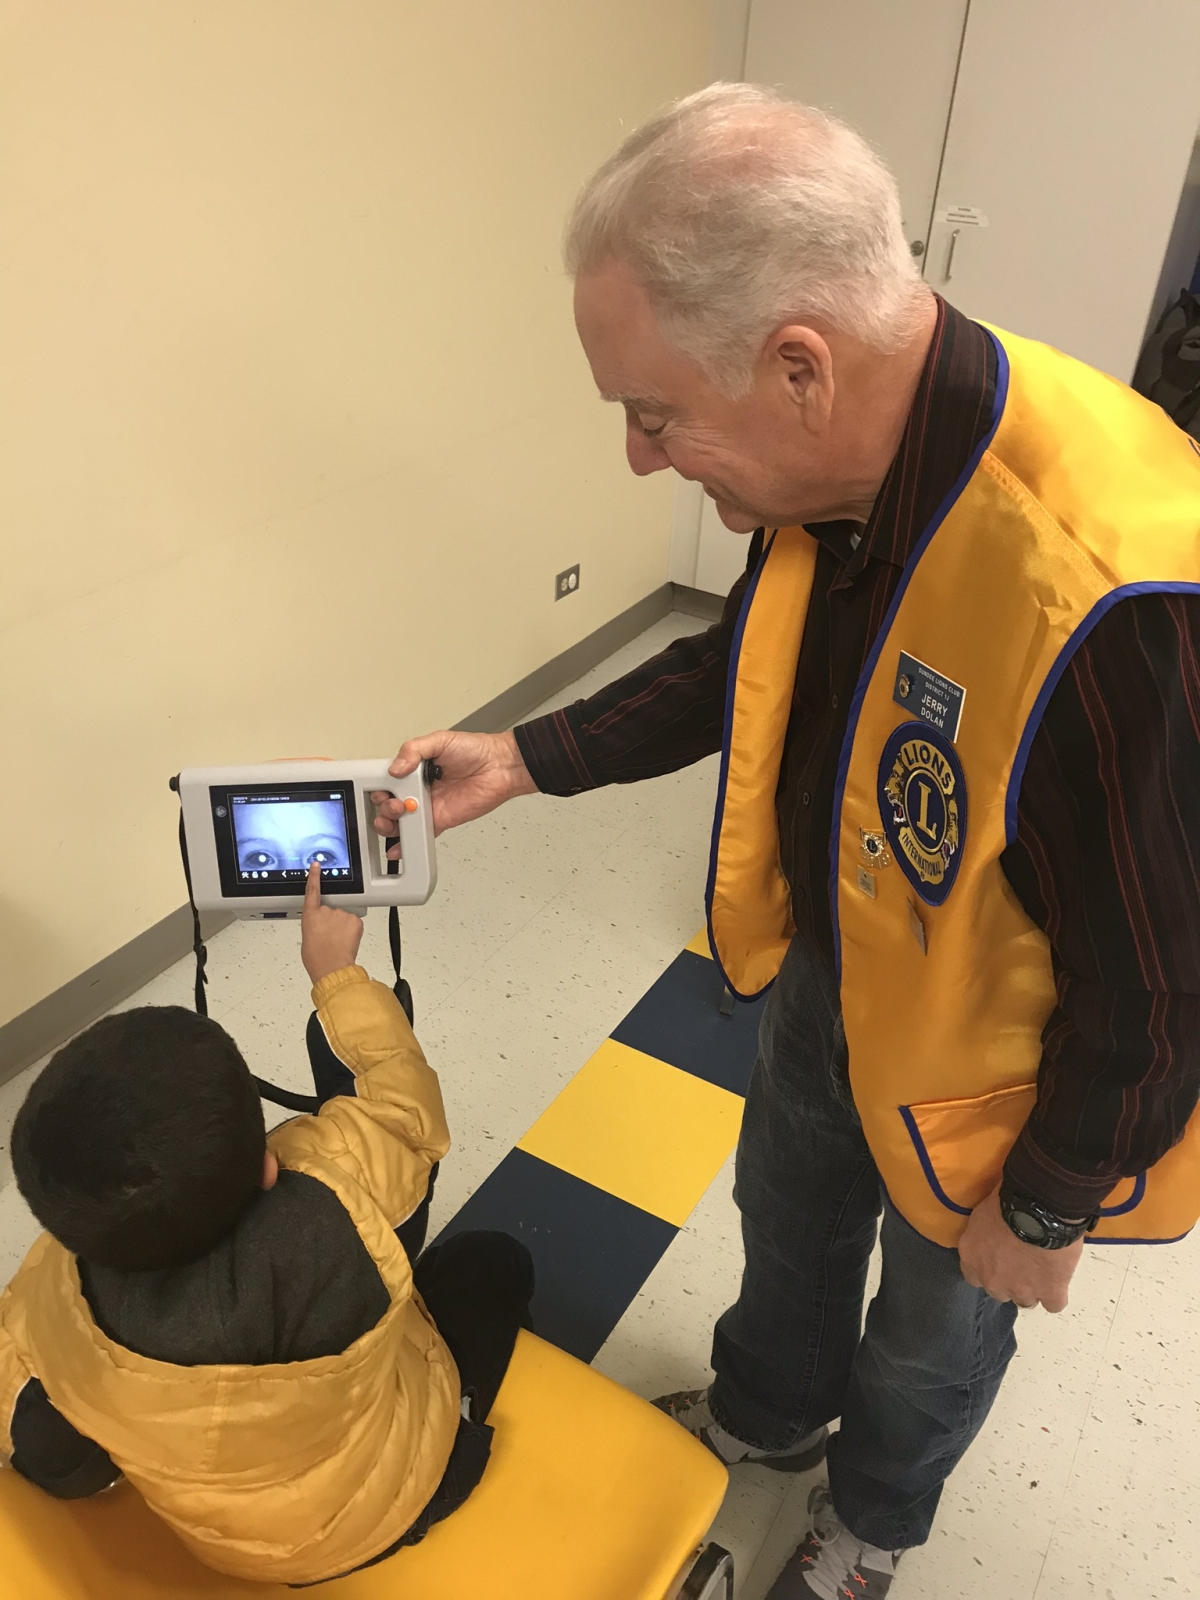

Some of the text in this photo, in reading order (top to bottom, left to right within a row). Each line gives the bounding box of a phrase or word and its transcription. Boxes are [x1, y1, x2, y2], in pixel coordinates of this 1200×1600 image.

[918, 667, 960, 698] DUNDEE LIONS CLUB
[925, 681, 944, 697] DISTRICT
[920, 707, 944, 729] DOLAN
[921, 694, 948, 717] JERRY
[903, 743, 952, 789] LIONS
[916, 781, 937, 840] L
[902, 833, 942, 877] INTERNATIONAL
